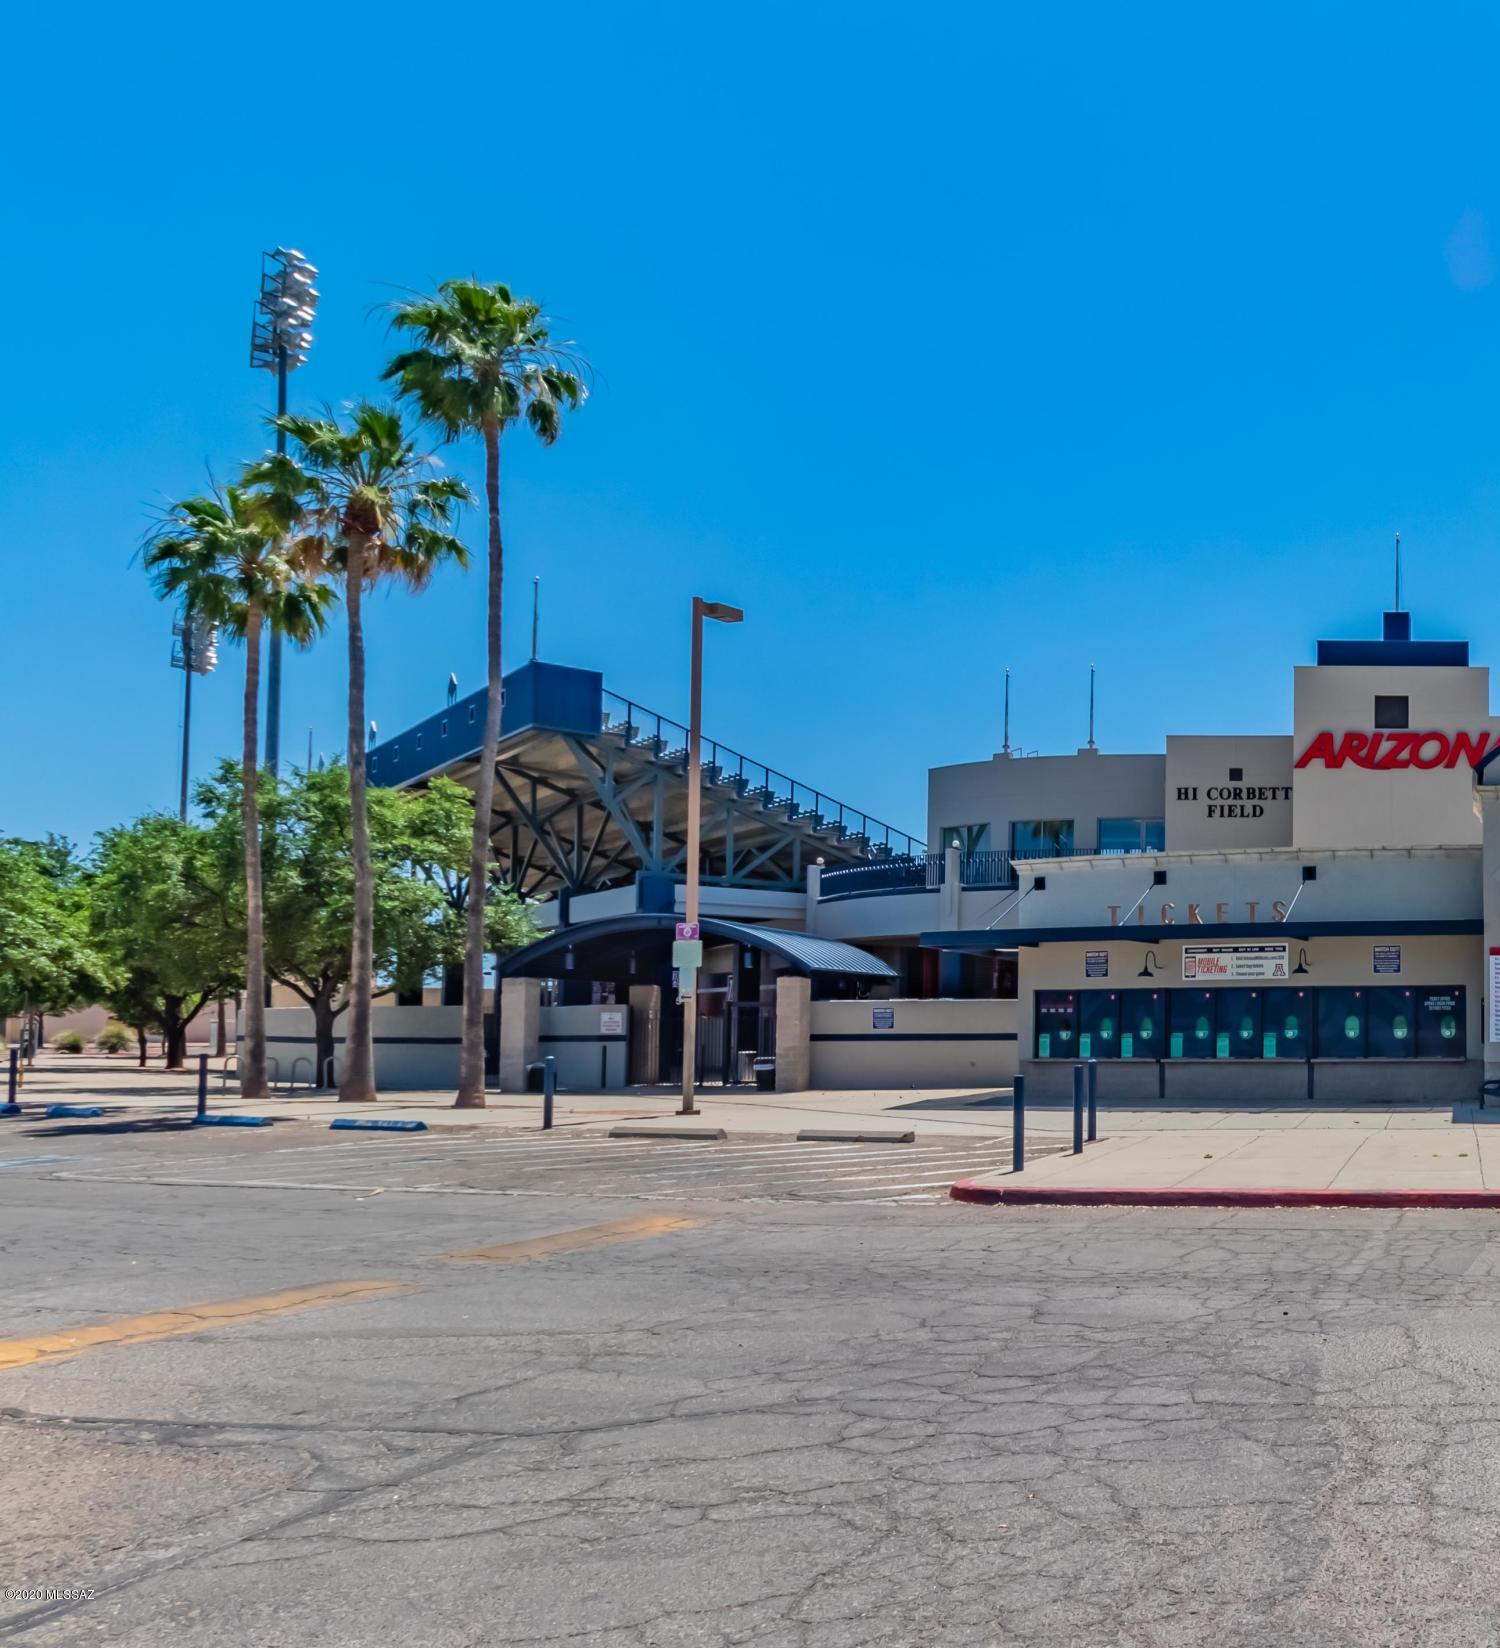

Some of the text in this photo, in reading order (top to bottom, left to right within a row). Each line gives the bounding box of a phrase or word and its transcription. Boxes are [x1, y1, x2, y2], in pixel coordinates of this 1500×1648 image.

[1176, 787, 1293, 800] HI CORBETT
[1207, 804, 1264, 817] FIELD
[1107, 901, 1287, 926] TICKETS
